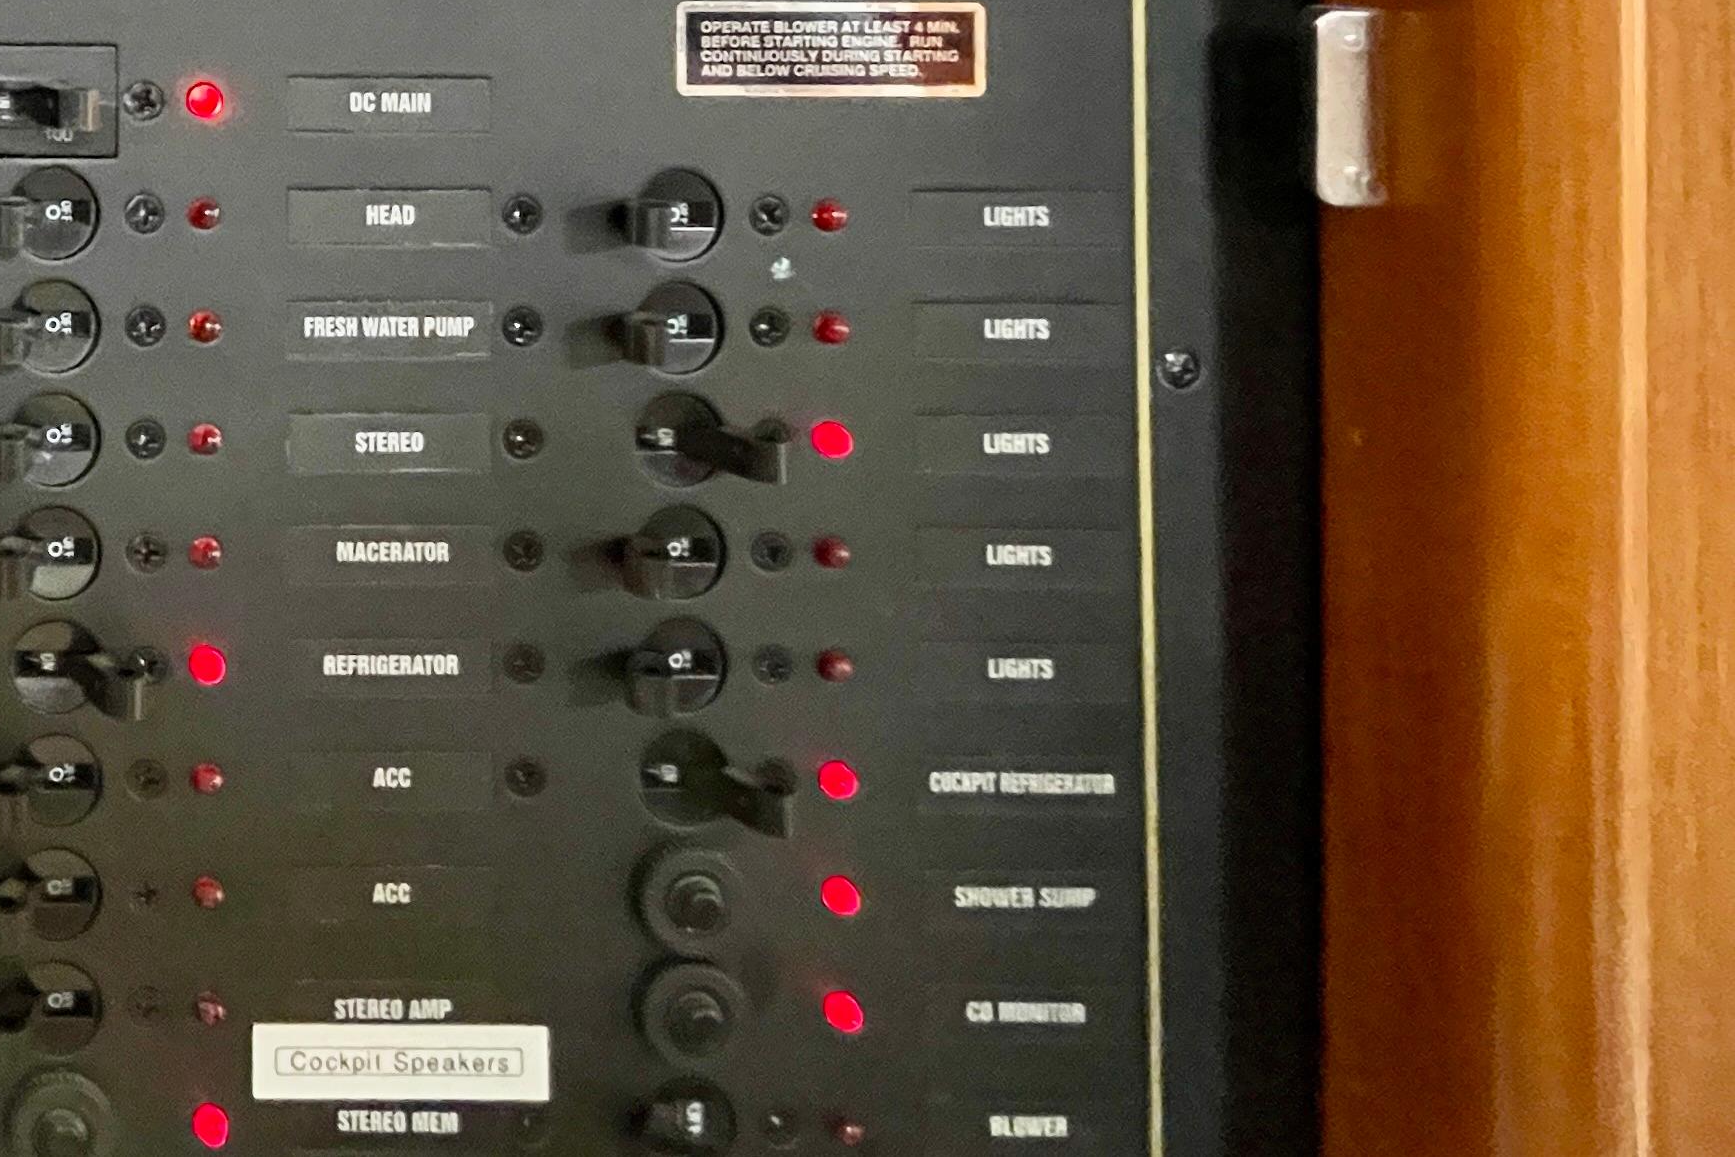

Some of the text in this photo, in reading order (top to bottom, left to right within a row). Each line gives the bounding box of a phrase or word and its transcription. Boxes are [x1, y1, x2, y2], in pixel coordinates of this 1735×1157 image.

[700, 20, 911, 34] OPERATE AT LEAST
[701, 35, 838, 49] BEFORE STARTING
[700, 49, 959, 63] CONTINUOUSLY DURING STARTING
[701, 64, 734, 77] AND
[736, 64, 791, 77] BELOW
[793, 63, 866, 77] CRUISING
[349, 91, 432, 113] DC MAIN
[365, 204, 416, 226] HEAD
[983, 205, 1050, 227] LIGHTS
[303, 316, 475, 338] FRESH WATER PUMP
[983, 318, 1050, 340] LIGHTS
[354, 431, 425, 454] STEREO
[983, 432, 1050, 454] LIGHTS
[336, 541, 450, 563] MACERATOR
[986, 544, 1052, 566] LIGHTS
[323, 654, 459, 676] REFRIGERATOR
[987, 658, 1054, 680] LIGHTS
[372, 767, 412, 789] ACC
[372, 882, 411, 904] ACC
[334, 997, 453, 1020] STEREO AMP
[290, 1050, 509, 1075] Cockpit Speakers
[337, 1109, 459, 1134] STEREO MEM
